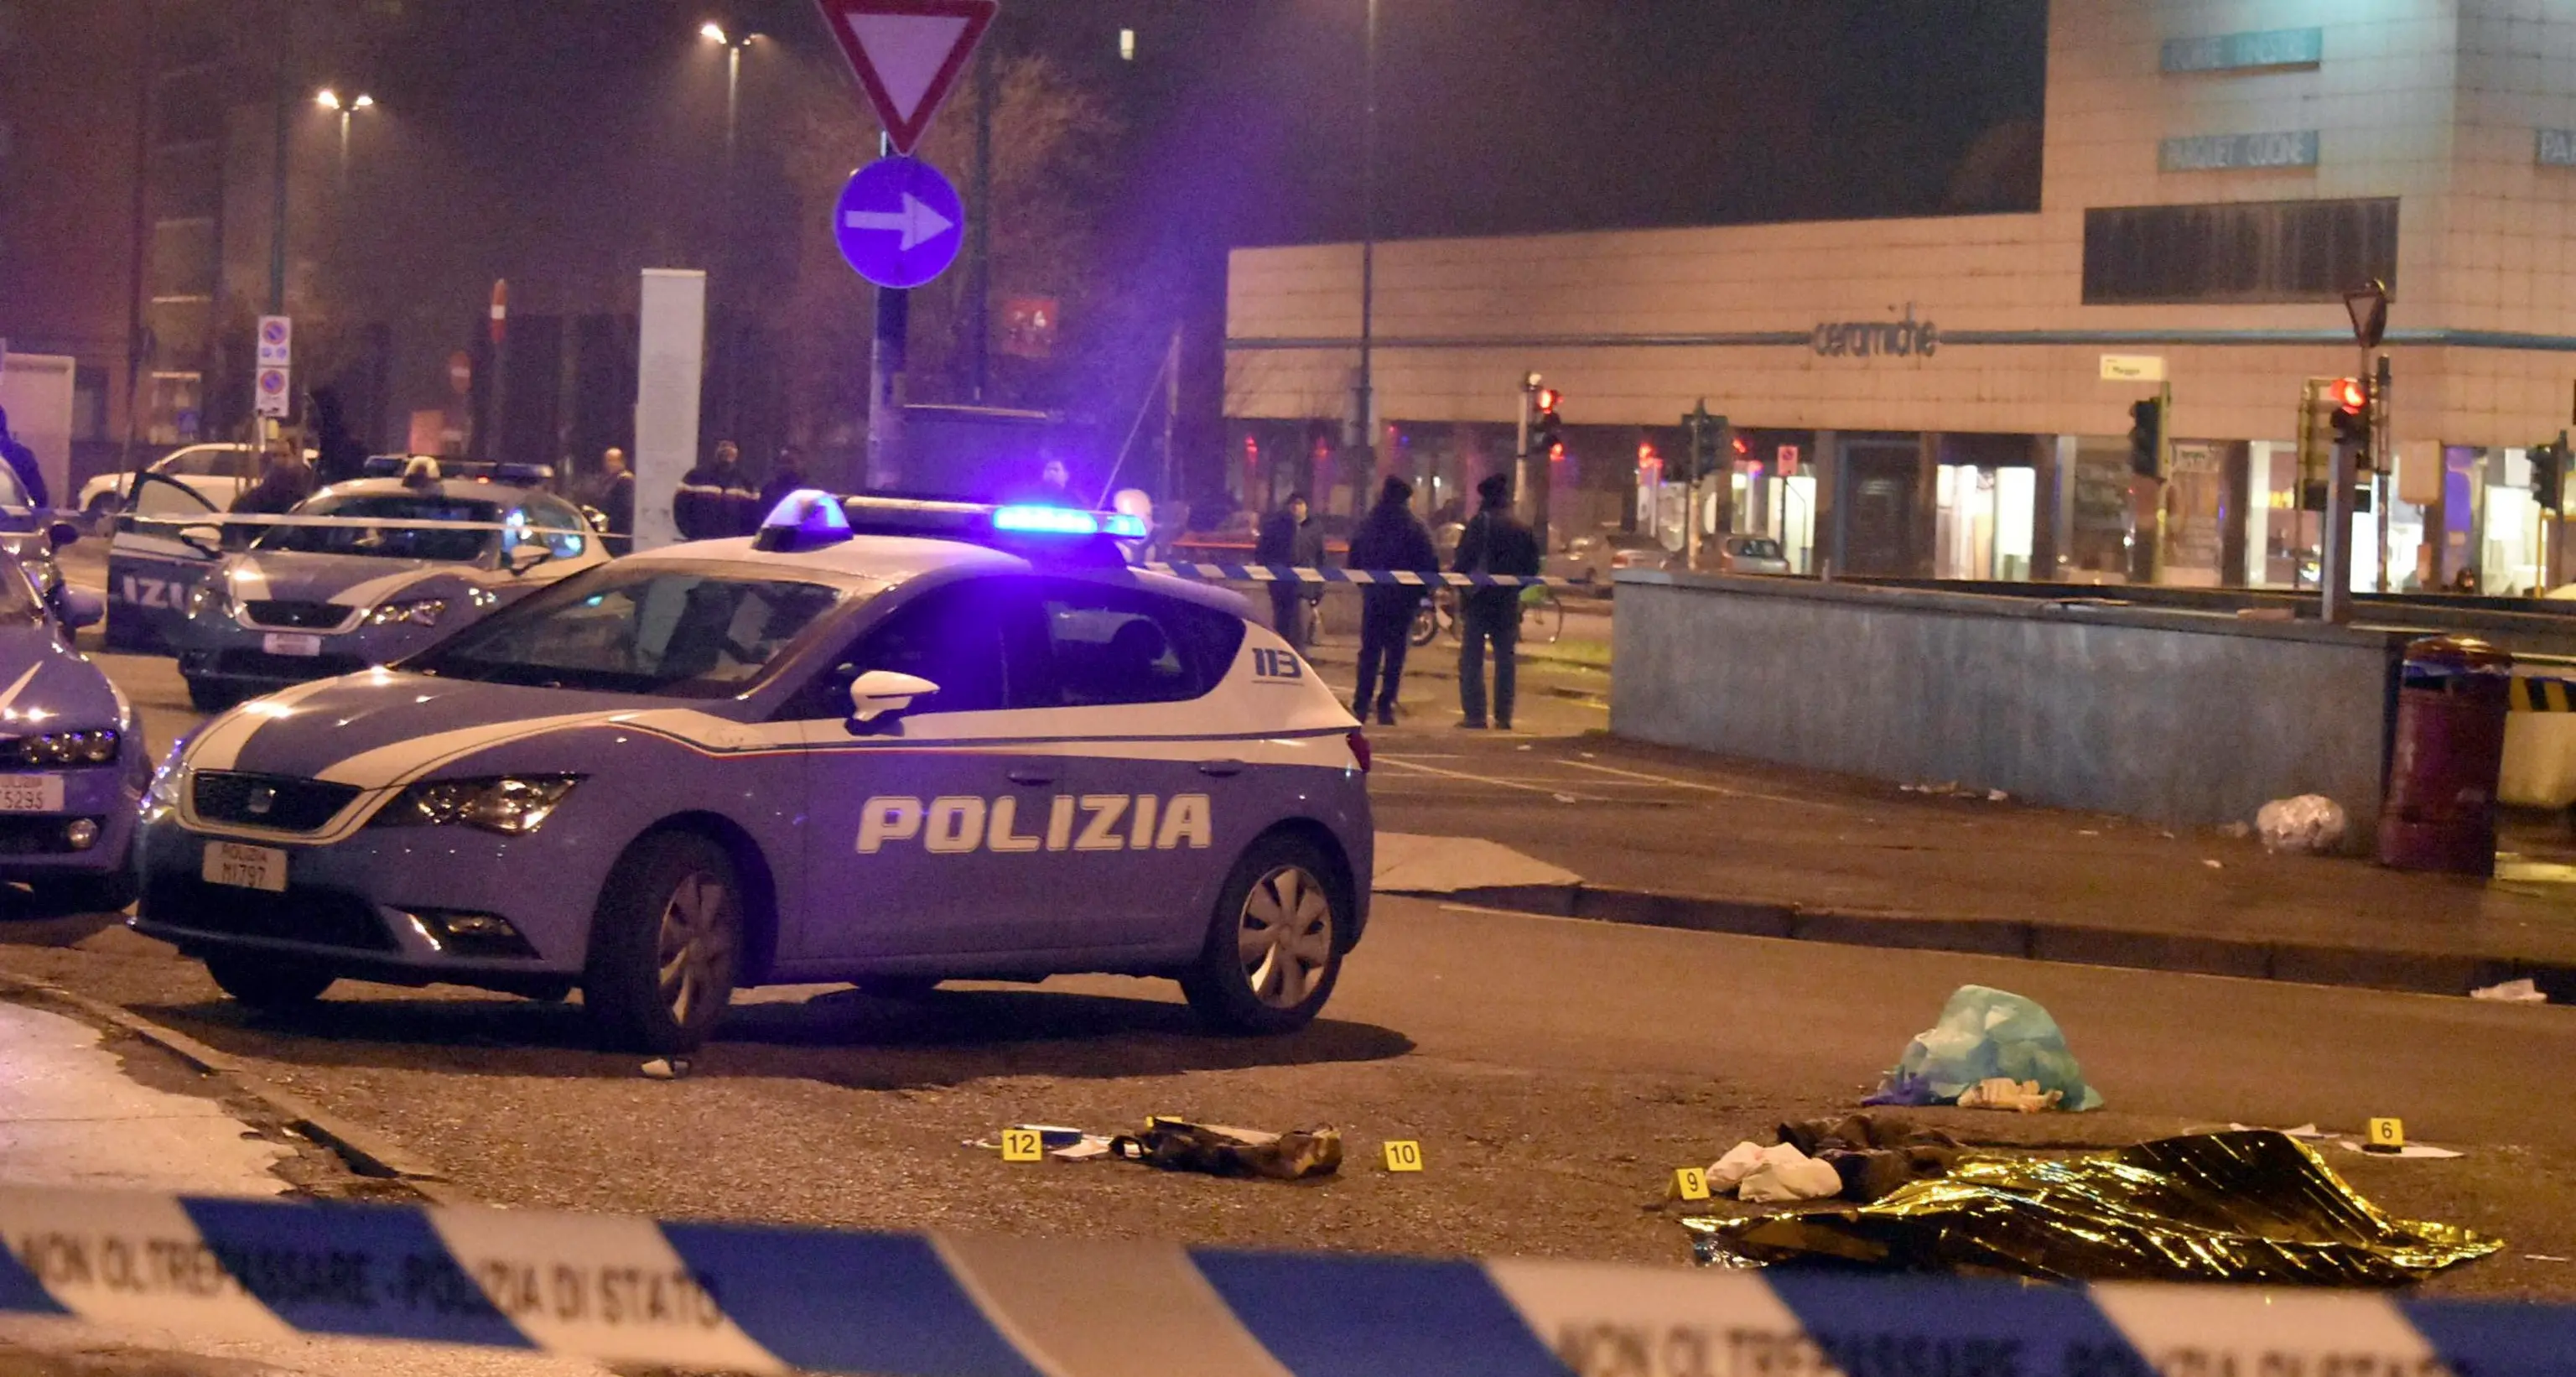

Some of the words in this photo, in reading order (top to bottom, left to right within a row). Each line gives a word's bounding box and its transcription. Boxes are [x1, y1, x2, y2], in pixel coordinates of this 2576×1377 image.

[1815, 301, 1936, 357] ceramiche
[1252, 647, 1302, 679] 113
[855, 793, 1213, 854] POLIZIA
[2381, 1121, 2393, 1139] 6
[1008, 1133, 1036, 1154] 12
[1390, 1144, 1415, 1164] 10
[1687, 1172, 1698, 1193] 9
[19, 1230, 93, 1284] NON
[553, 1263, 590, 1323] DI
[598, 1265, 725, 1329] STATO
